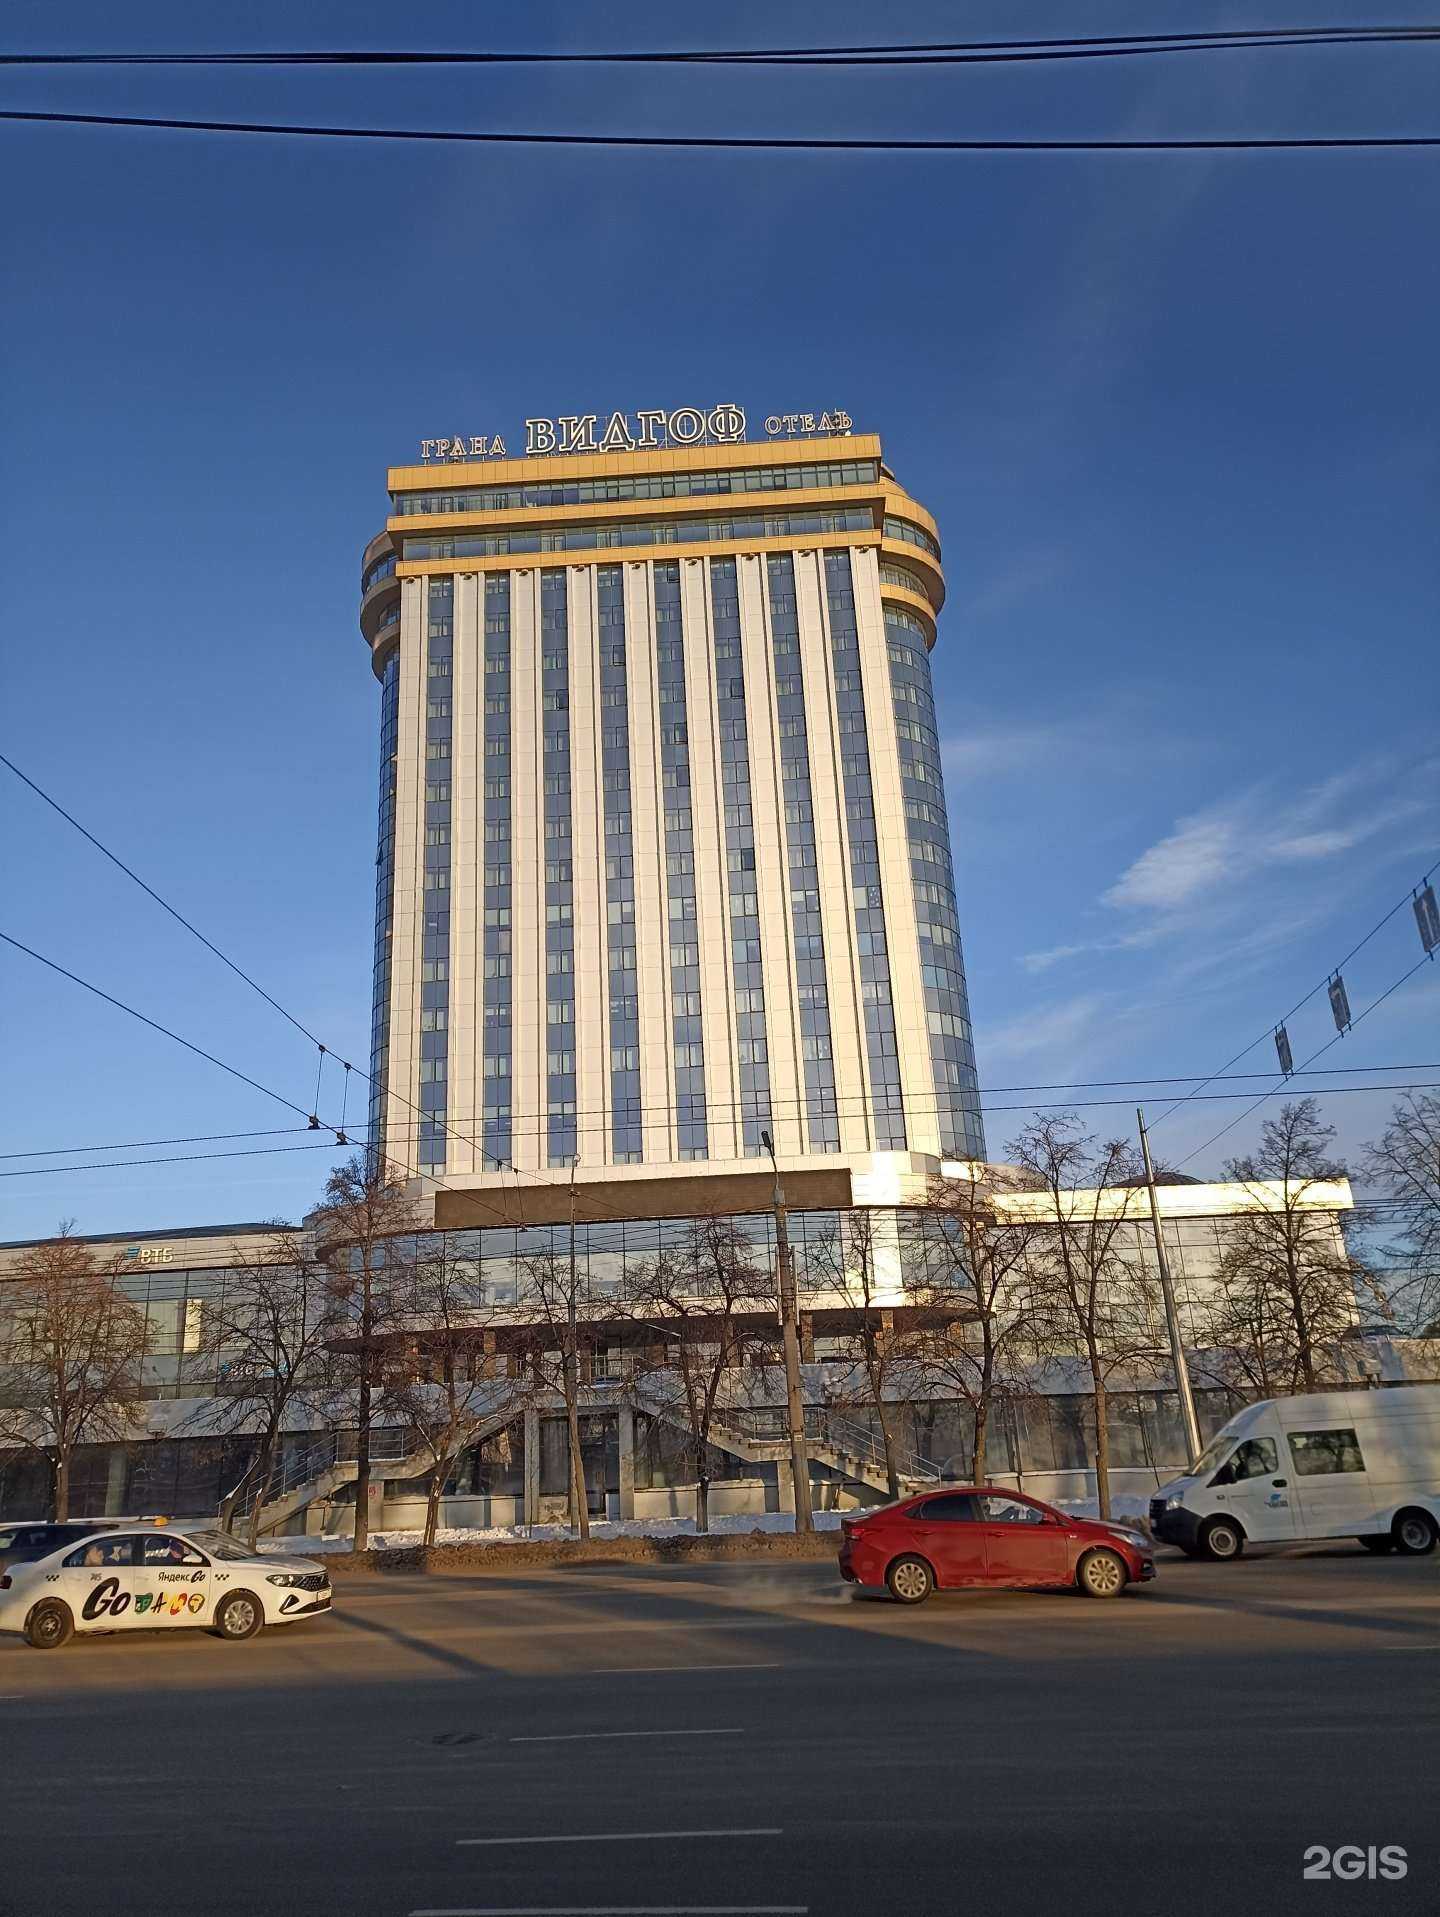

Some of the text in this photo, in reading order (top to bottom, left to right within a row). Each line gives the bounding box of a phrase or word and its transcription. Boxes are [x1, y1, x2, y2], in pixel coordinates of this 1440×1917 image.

[421, 435, 506, 458] ГРАНД
[526, 404, 746, 454] ВИДГОФ
[140, 1247, 173, 1264] ВТБ
[158, 1570, 206, 1583] Яндекс Go
[82, 1577, 131, 1621] Go
